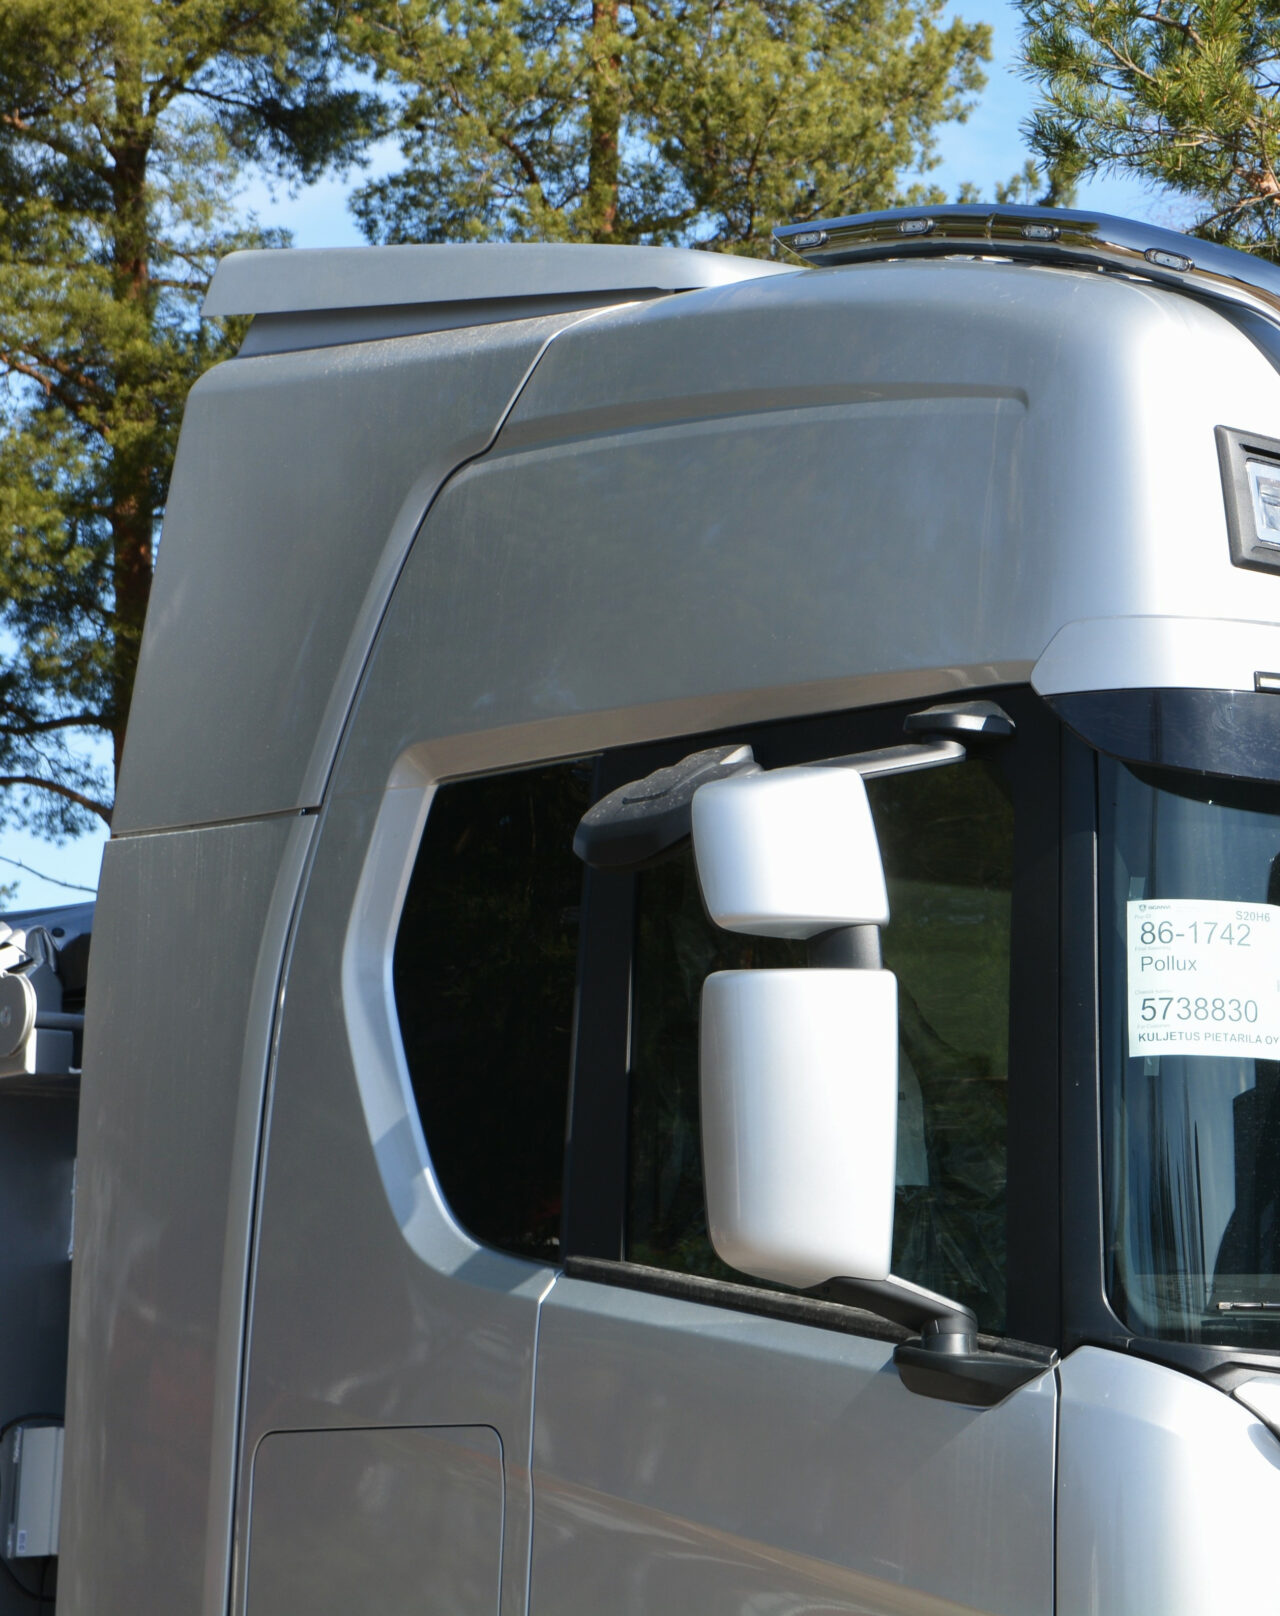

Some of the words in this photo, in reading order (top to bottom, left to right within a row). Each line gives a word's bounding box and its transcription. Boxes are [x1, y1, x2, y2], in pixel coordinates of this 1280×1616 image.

[1235, 910, 1271, 922] S20H6
[1140, 920, 1252, 947] 86-1742
[1140, 955, 1198, 972] Pollux
[1141, 997, 1259, 1023] 5738830
[1138, 1031, 1200, 1043] KULJETUS
[1204, 1032, 1262, 1044] PIETARILA
[1265, 1035, 1280, 1045] OY
